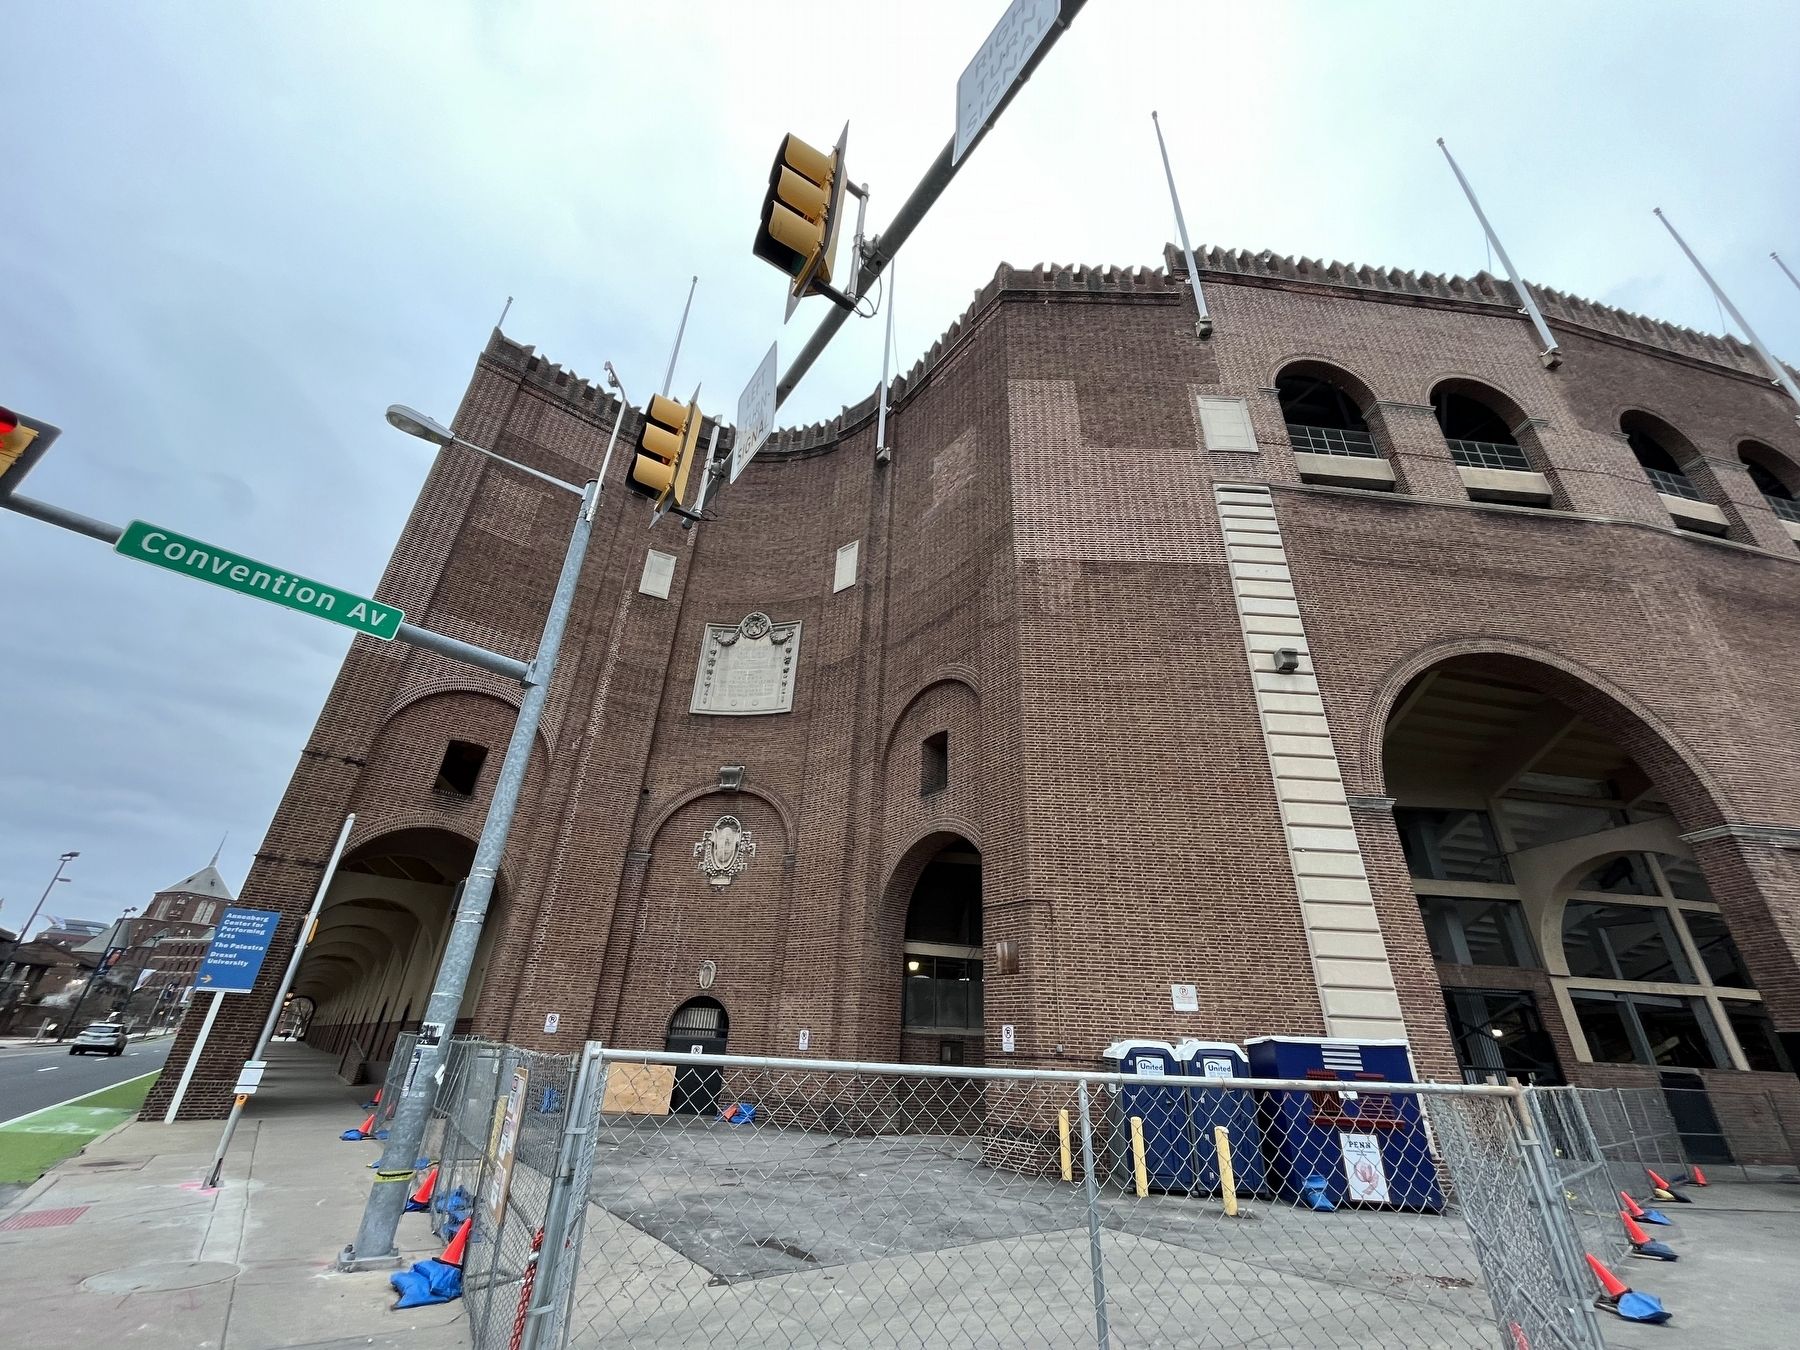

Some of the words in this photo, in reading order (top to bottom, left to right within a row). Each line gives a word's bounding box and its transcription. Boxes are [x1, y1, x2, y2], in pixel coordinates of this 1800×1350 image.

[975, 0, 1026, 78] RIGH
[977, 4, 1037, 94] TURN
[965, 16, 1050, 138] SIGNAL
[746, 368, 766, 408] LEFT
[744, 389, 768, 433] TURN
[737, 413, 769, 466] SIGNAL
[141, 532, 336, 612] Convention
[347, 602, 388, 627] Av
[223, 919, 251, 927] Center
[226, 913, 270, 923] Annenberg
[220, 926, 266, 936] Performing
[229, 943, 264, 951] Palestra
[207, 958, 249, 967] University
[1140, 1063, 1164, 1071] United
[1207, 1064, 1232, 1073] United
[1348, 1141, 1372, 1149] PENN
